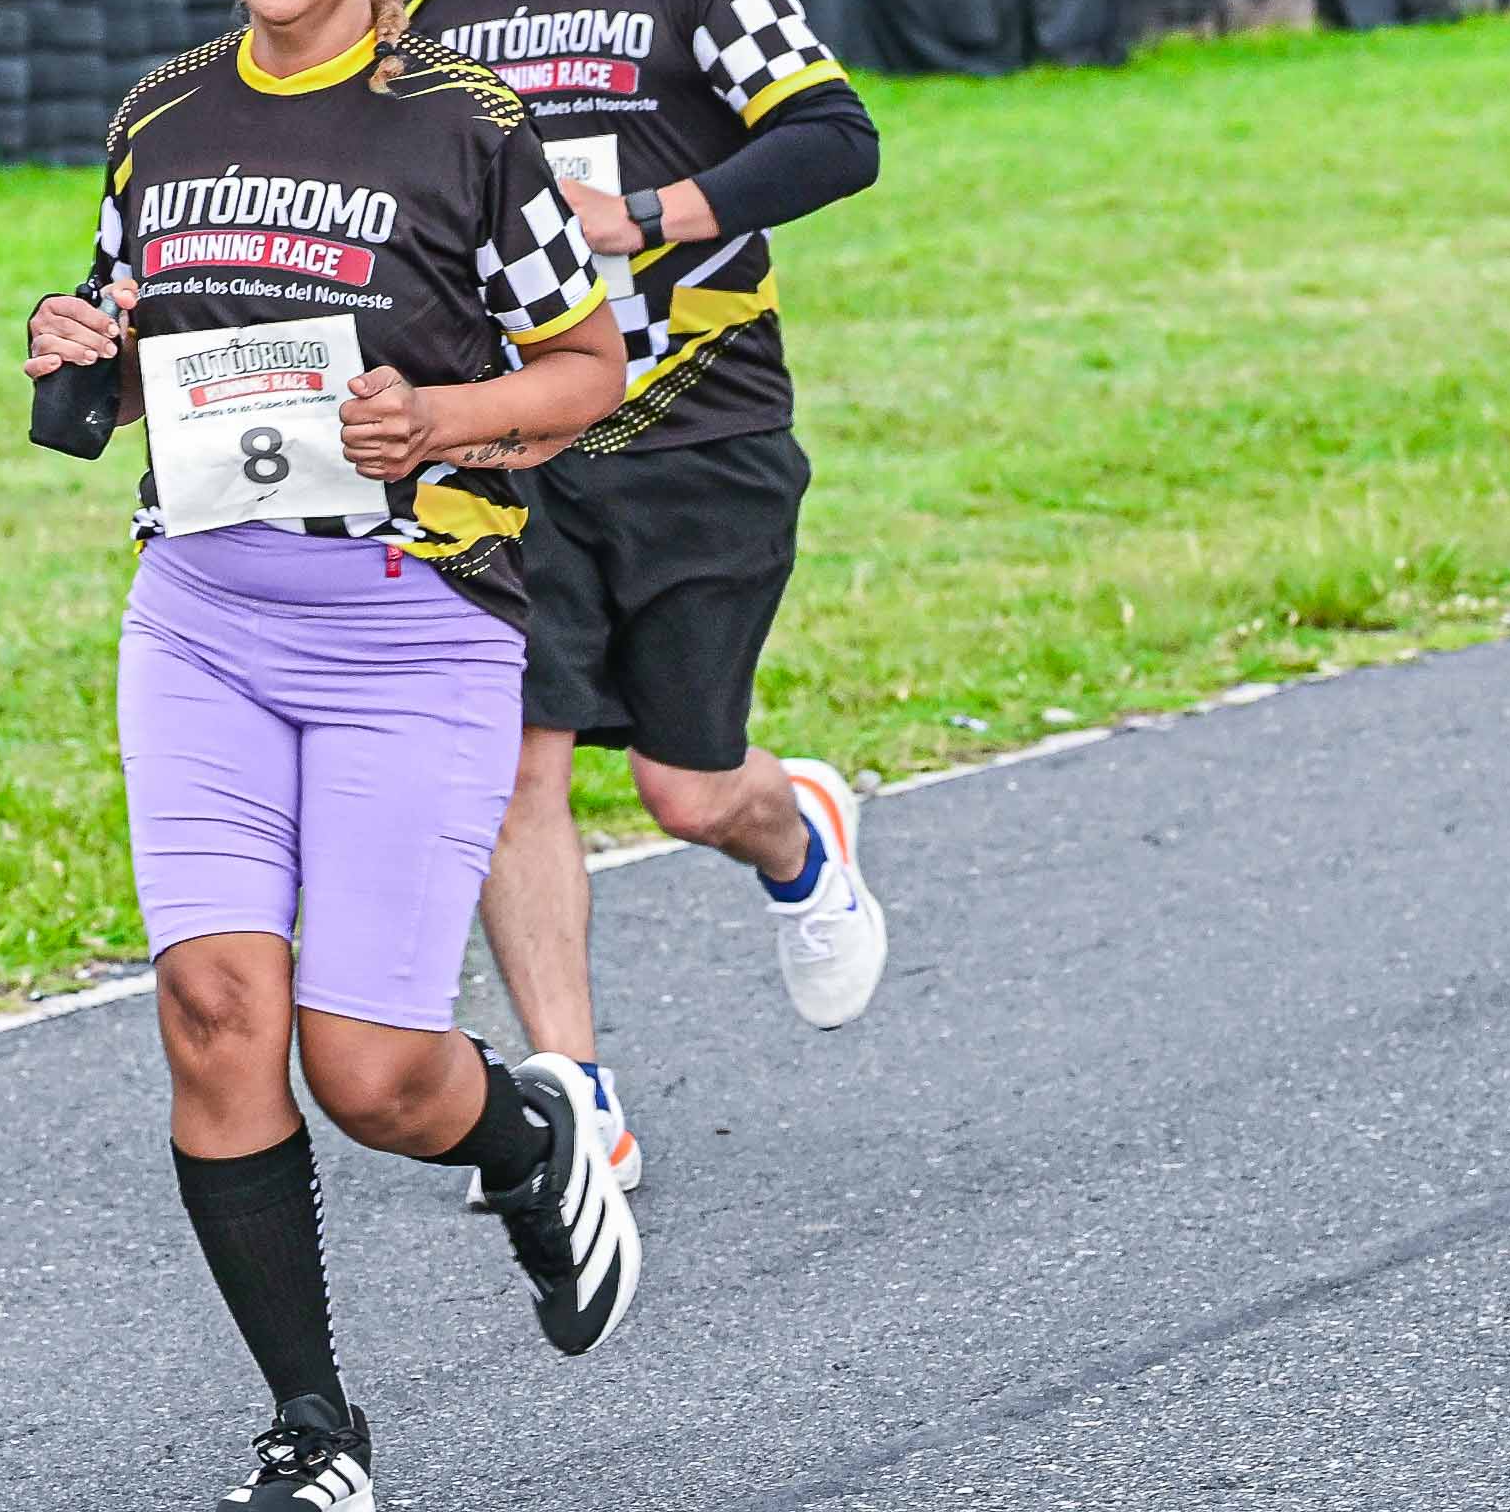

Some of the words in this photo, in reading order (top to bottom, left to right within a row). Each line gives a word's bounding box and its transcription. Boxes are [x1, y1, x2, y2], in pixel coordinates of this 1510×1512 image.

[558, 61, 612, 88] RACE
[137, 164, 398, 244] AUTÓDROMO
[160, 234, 265, 268] RUNNING
[270, 237, 343, 277] RACE
[183, 276, 204, 294] de
[205, 276, 229, 295] los
[230, 278, 283, 299] Clubes
[285, 282, 312, 302] del
[315, 285, 393, 310] Noroeste
[175, 338, 330, 387] AUTÓDROMO
[240, 426, 290, 484] 8
